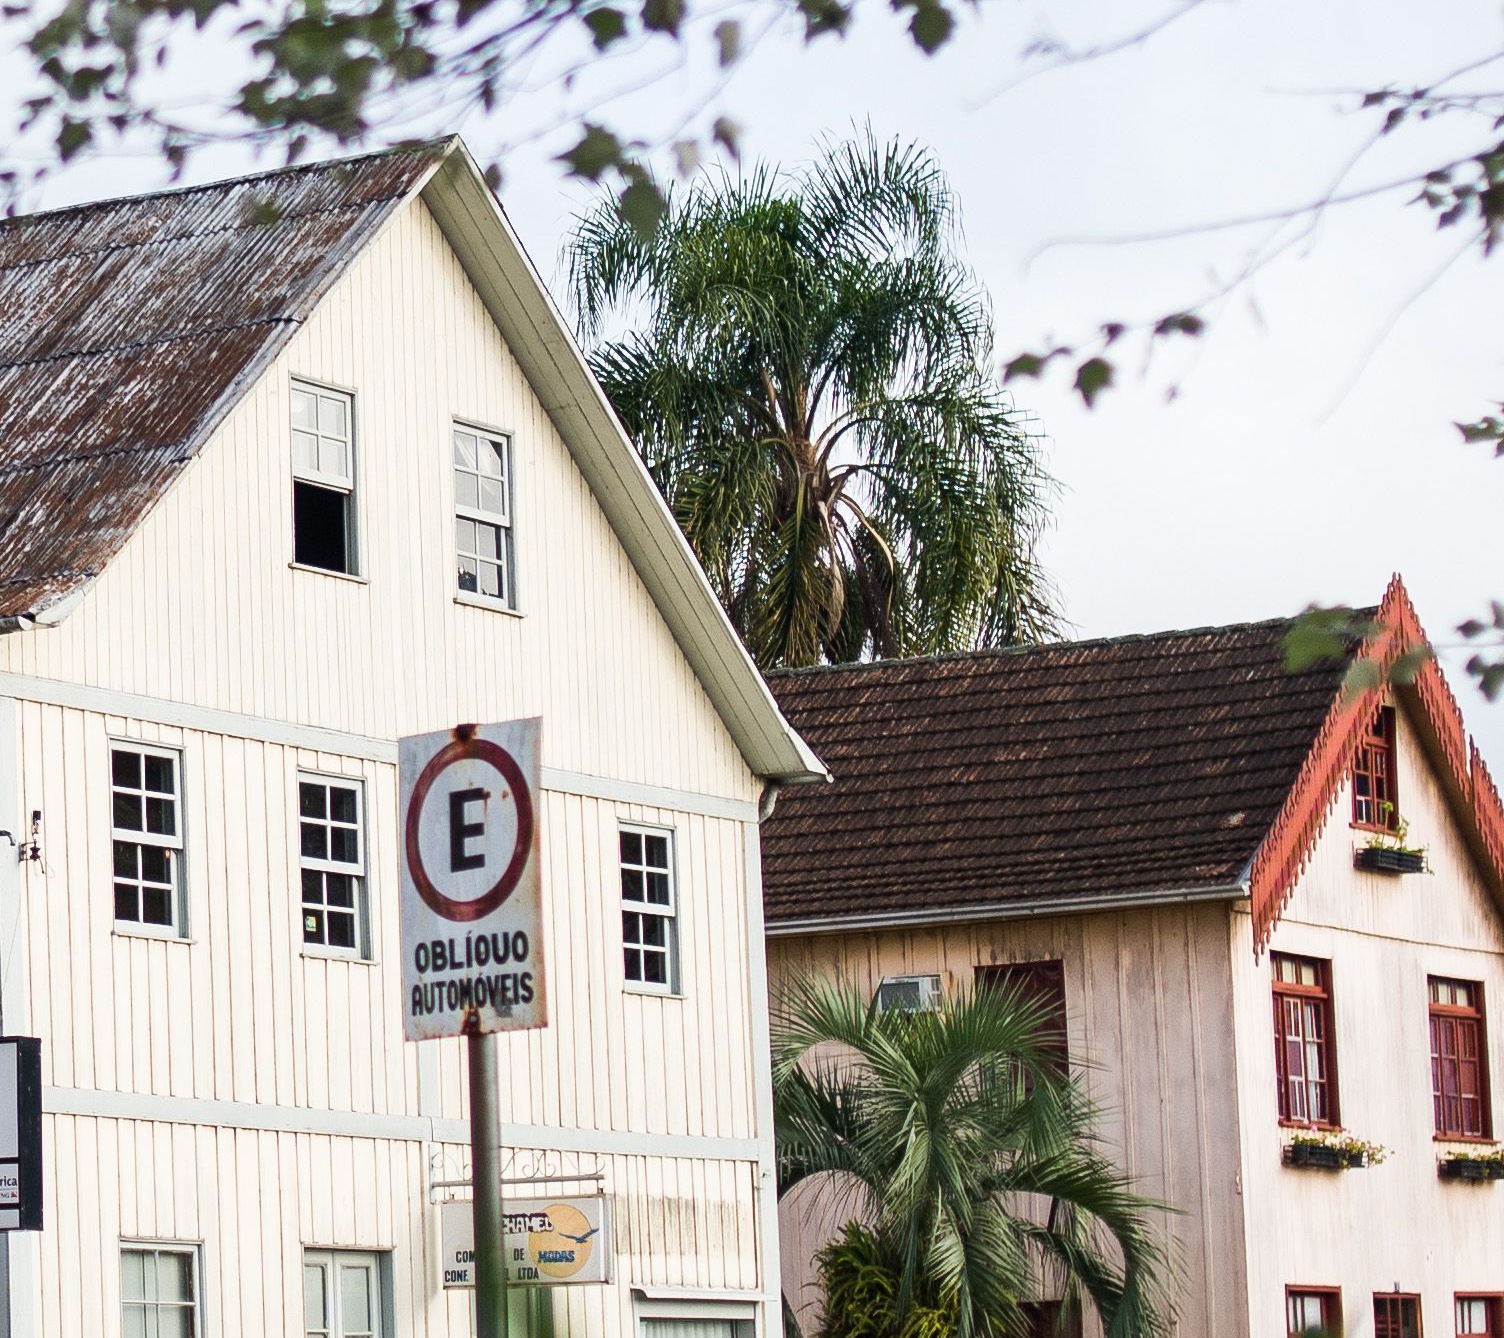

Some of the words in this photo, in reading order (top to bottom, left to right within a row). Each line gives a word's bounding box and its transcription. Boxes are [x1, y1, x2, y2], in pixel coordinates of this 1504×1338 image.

[449, 788, 486, 873] E
[412, 972, 534, 1016] AUTOMÓVEIS
[513, 1248, 525, 1261] DE
[517, 1267, 539, 1280] LTDA
